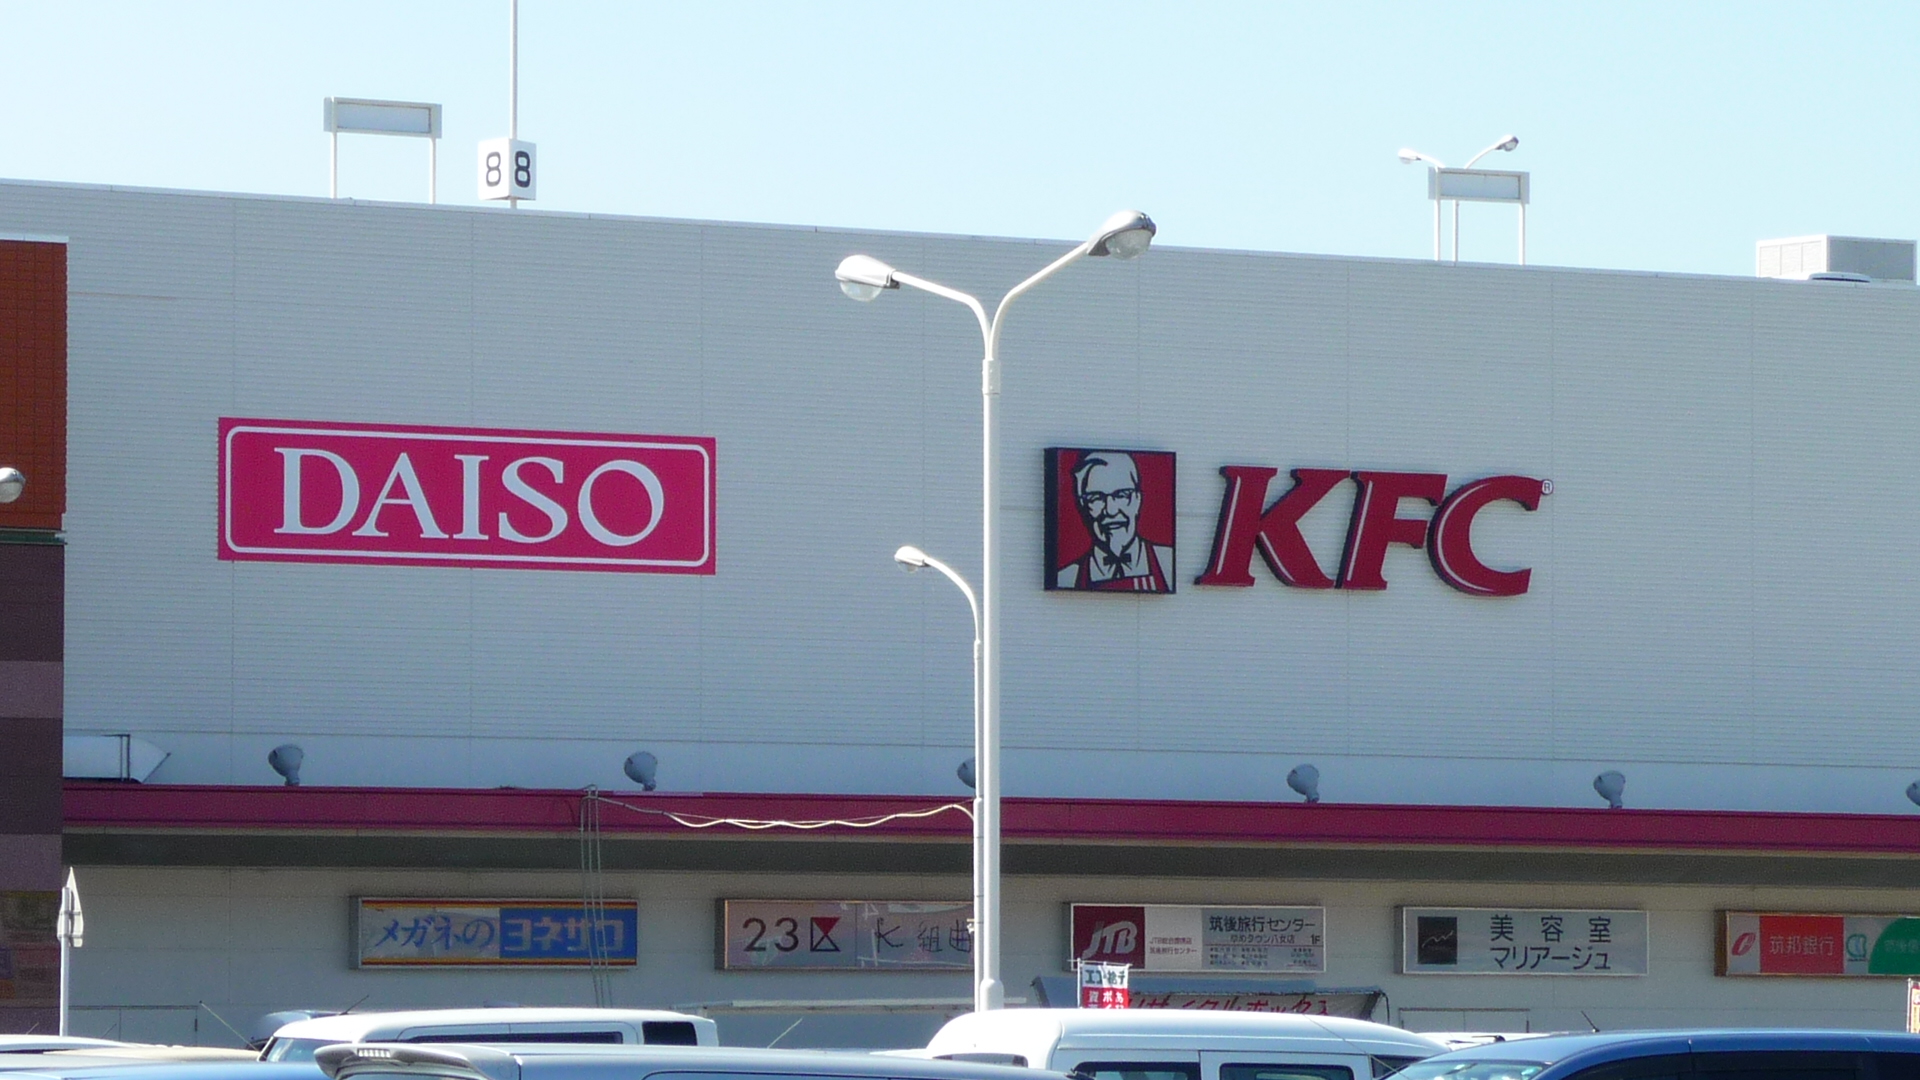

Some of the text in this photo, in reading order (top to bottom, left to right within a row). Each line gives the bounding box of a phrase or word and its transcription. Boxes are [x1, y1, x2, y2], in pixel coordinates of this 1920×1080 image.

[485, 151, 502, 187] 8
[514, 150, 532, 187] 8
[274, 446, 666, 547] DAISO
[1194, 465, 1543, 597] KFC
[1081, 920, 1138, 960] JTB
[1209, 915, 1316, 933] 筑後旅行センター
[1490, 914, 1611, 943] 美容室
[1490, 946, 1611, 970] マリアージュ
[1769, 935, 1835, 956] 筑邦銀行
